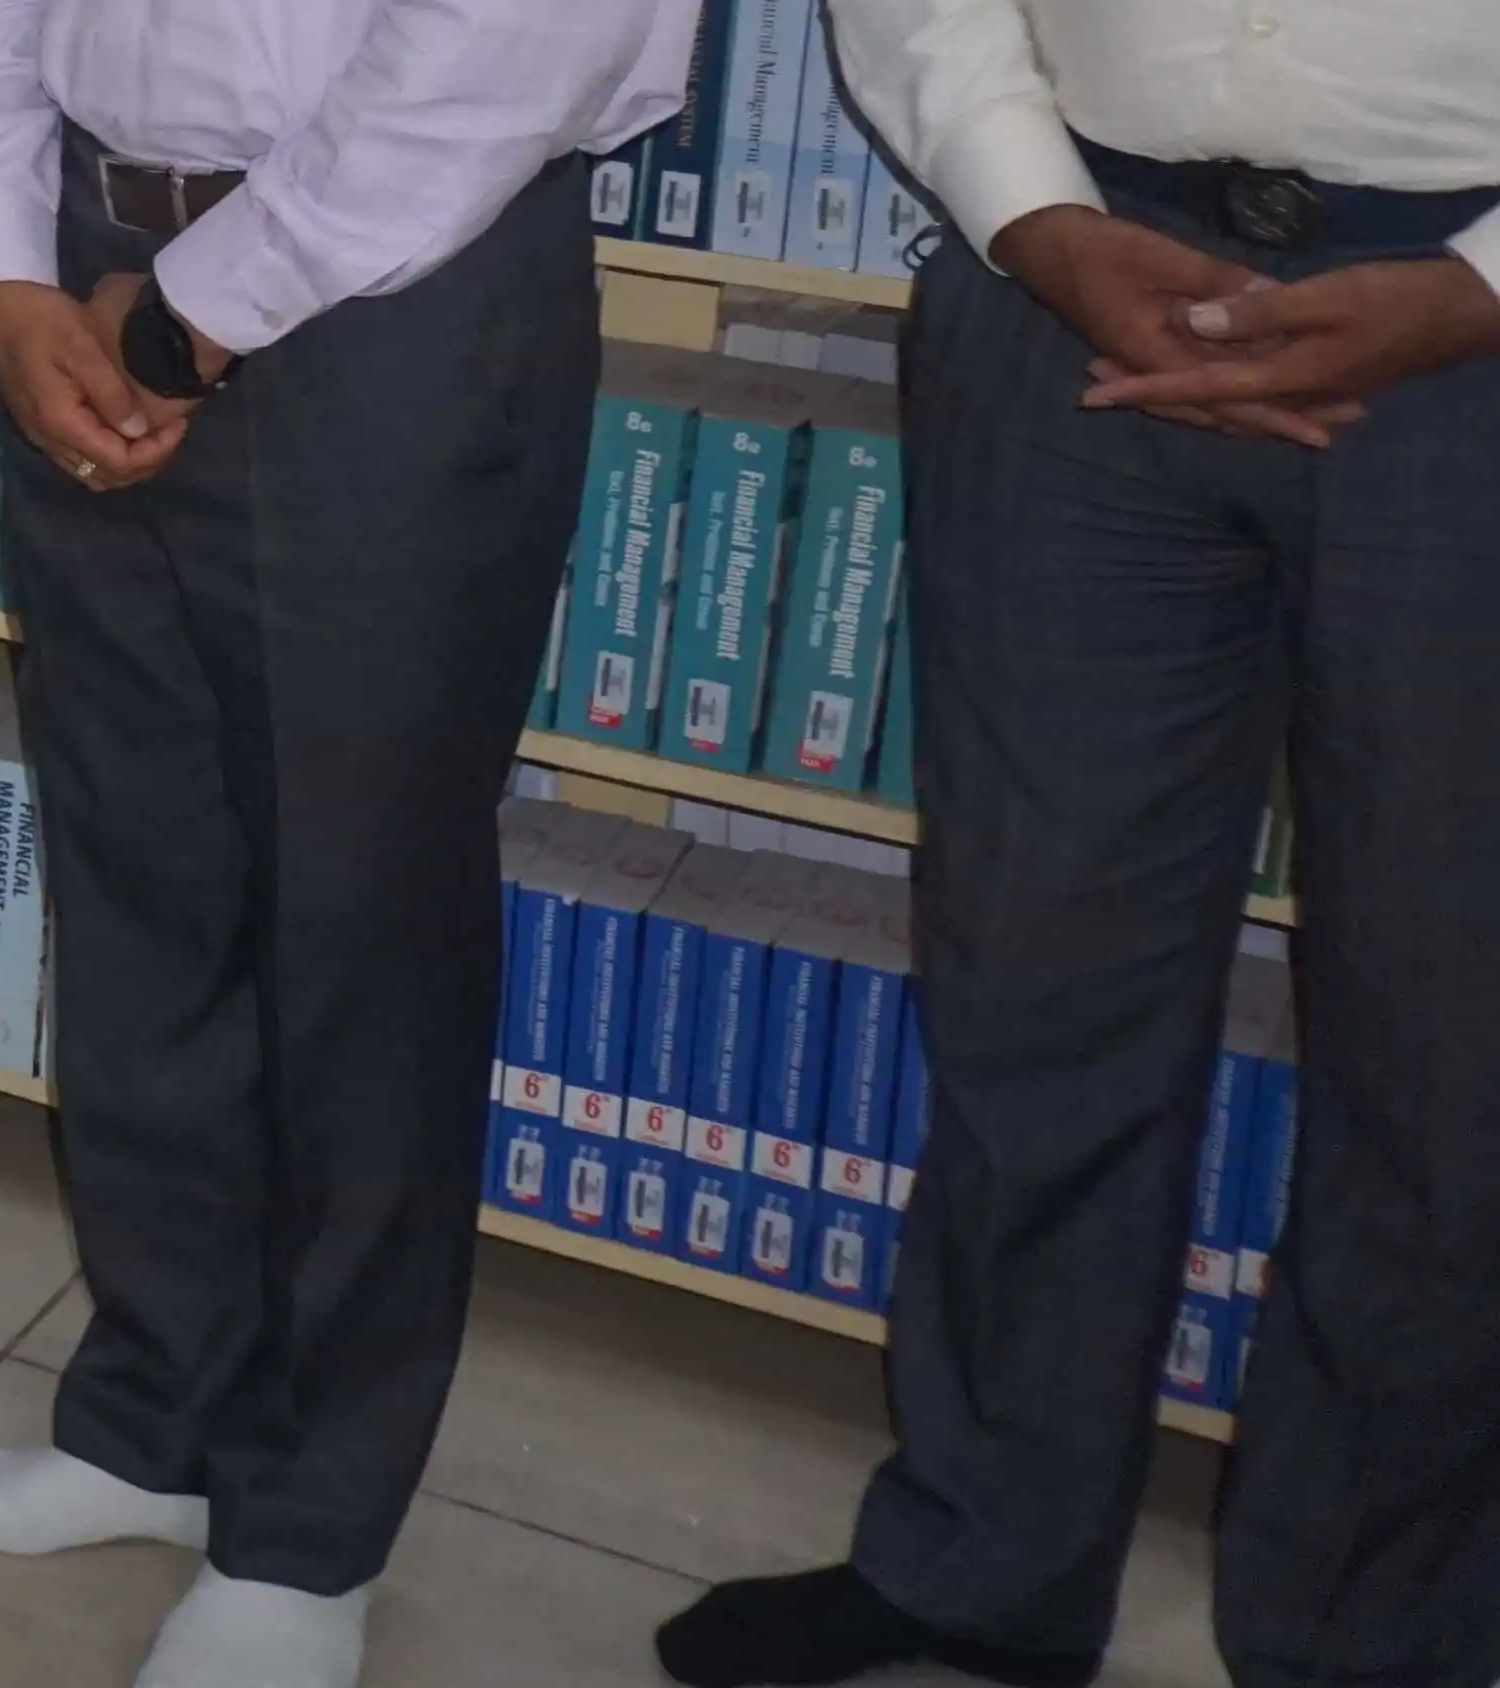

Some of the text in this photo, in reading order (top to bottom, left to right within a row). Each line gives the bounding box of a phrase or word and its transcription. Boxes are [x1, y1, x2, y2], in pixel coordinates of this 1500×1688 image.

[746, 61, 779, 164] Management
[614, 449, 661, 638] Financial Management
[716, 469, 766, 660] Financial Management
[848, 485, 886, 566] Financial
[13, 801, 36, 898] FINANCIAL
